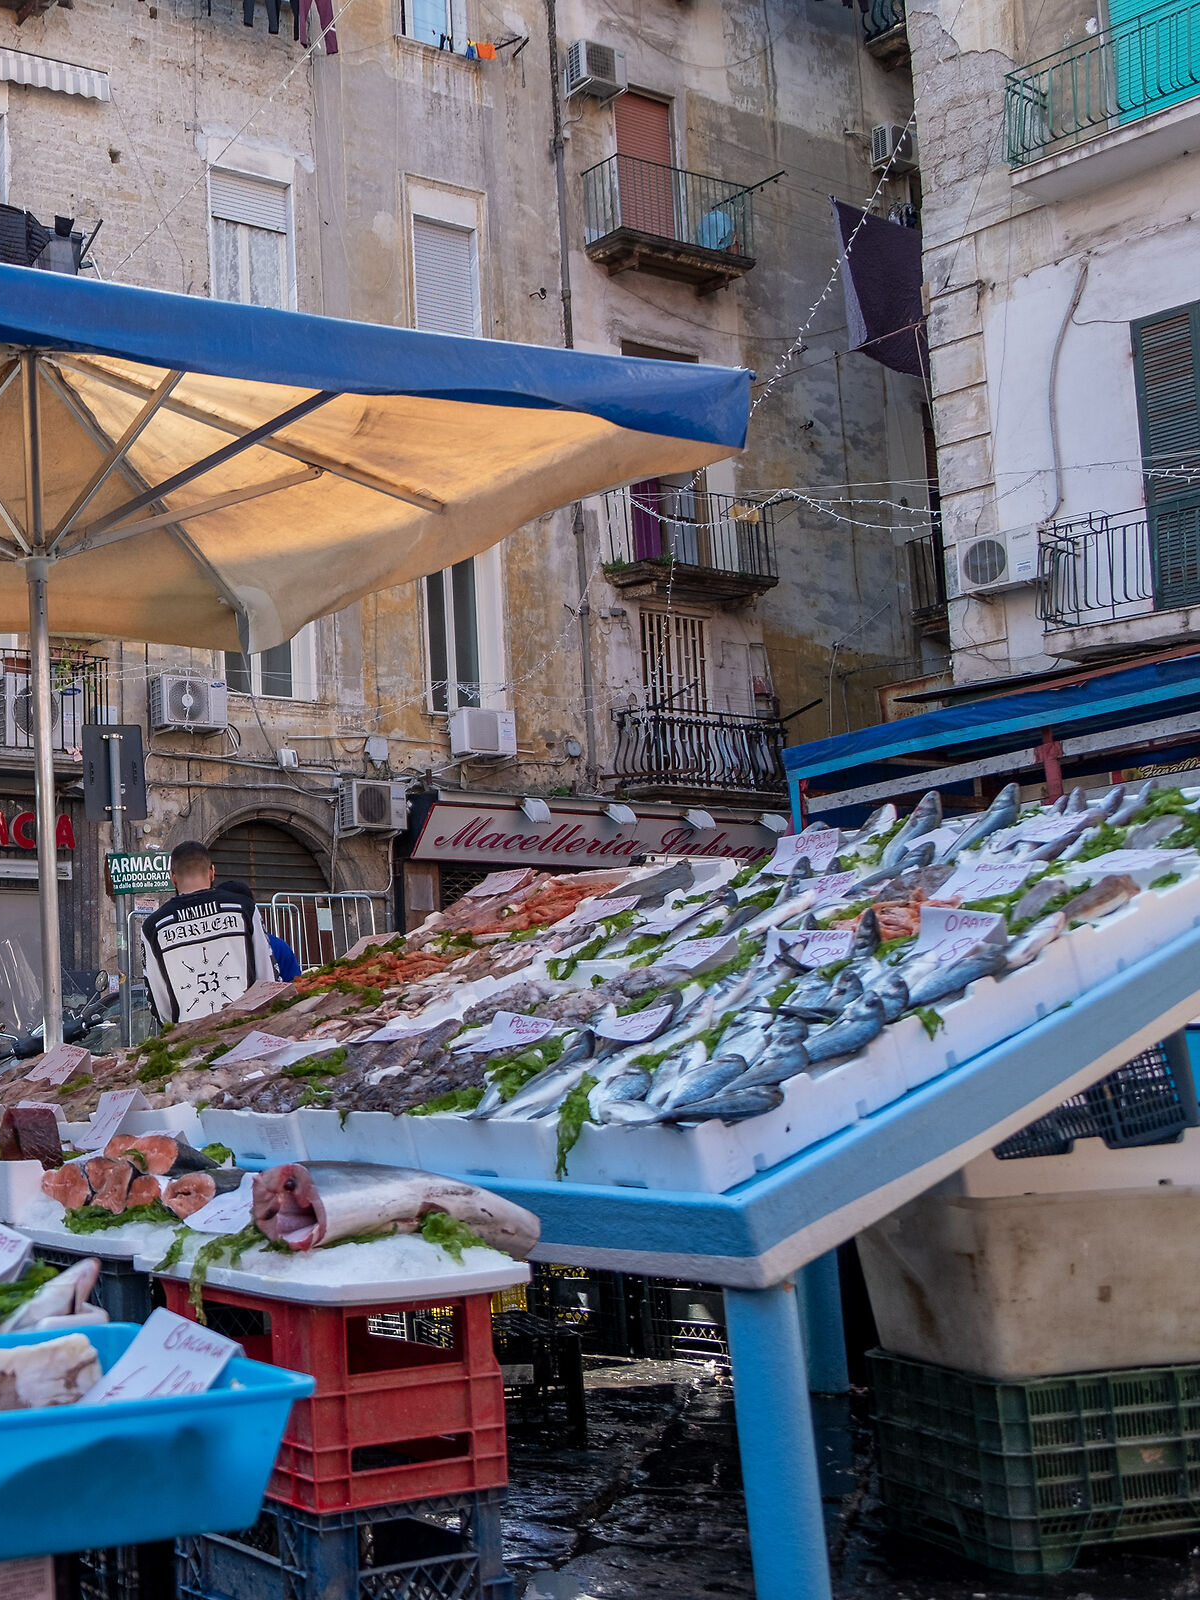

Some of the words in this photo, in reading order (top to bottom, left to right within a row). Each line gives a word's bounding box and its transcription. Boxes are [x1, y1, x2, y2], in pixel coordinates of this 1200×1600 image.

[433, 816, 648, 857] Macelleria
[108, 856, 172, 873] ARMACI
[111, 872, 171, 883] LL'ADDOLORATA
[177, 900, 218, 921] MCMLIII
[163, 915, 238, 942] HARLEM
[197, 970, 221, 995] 53
